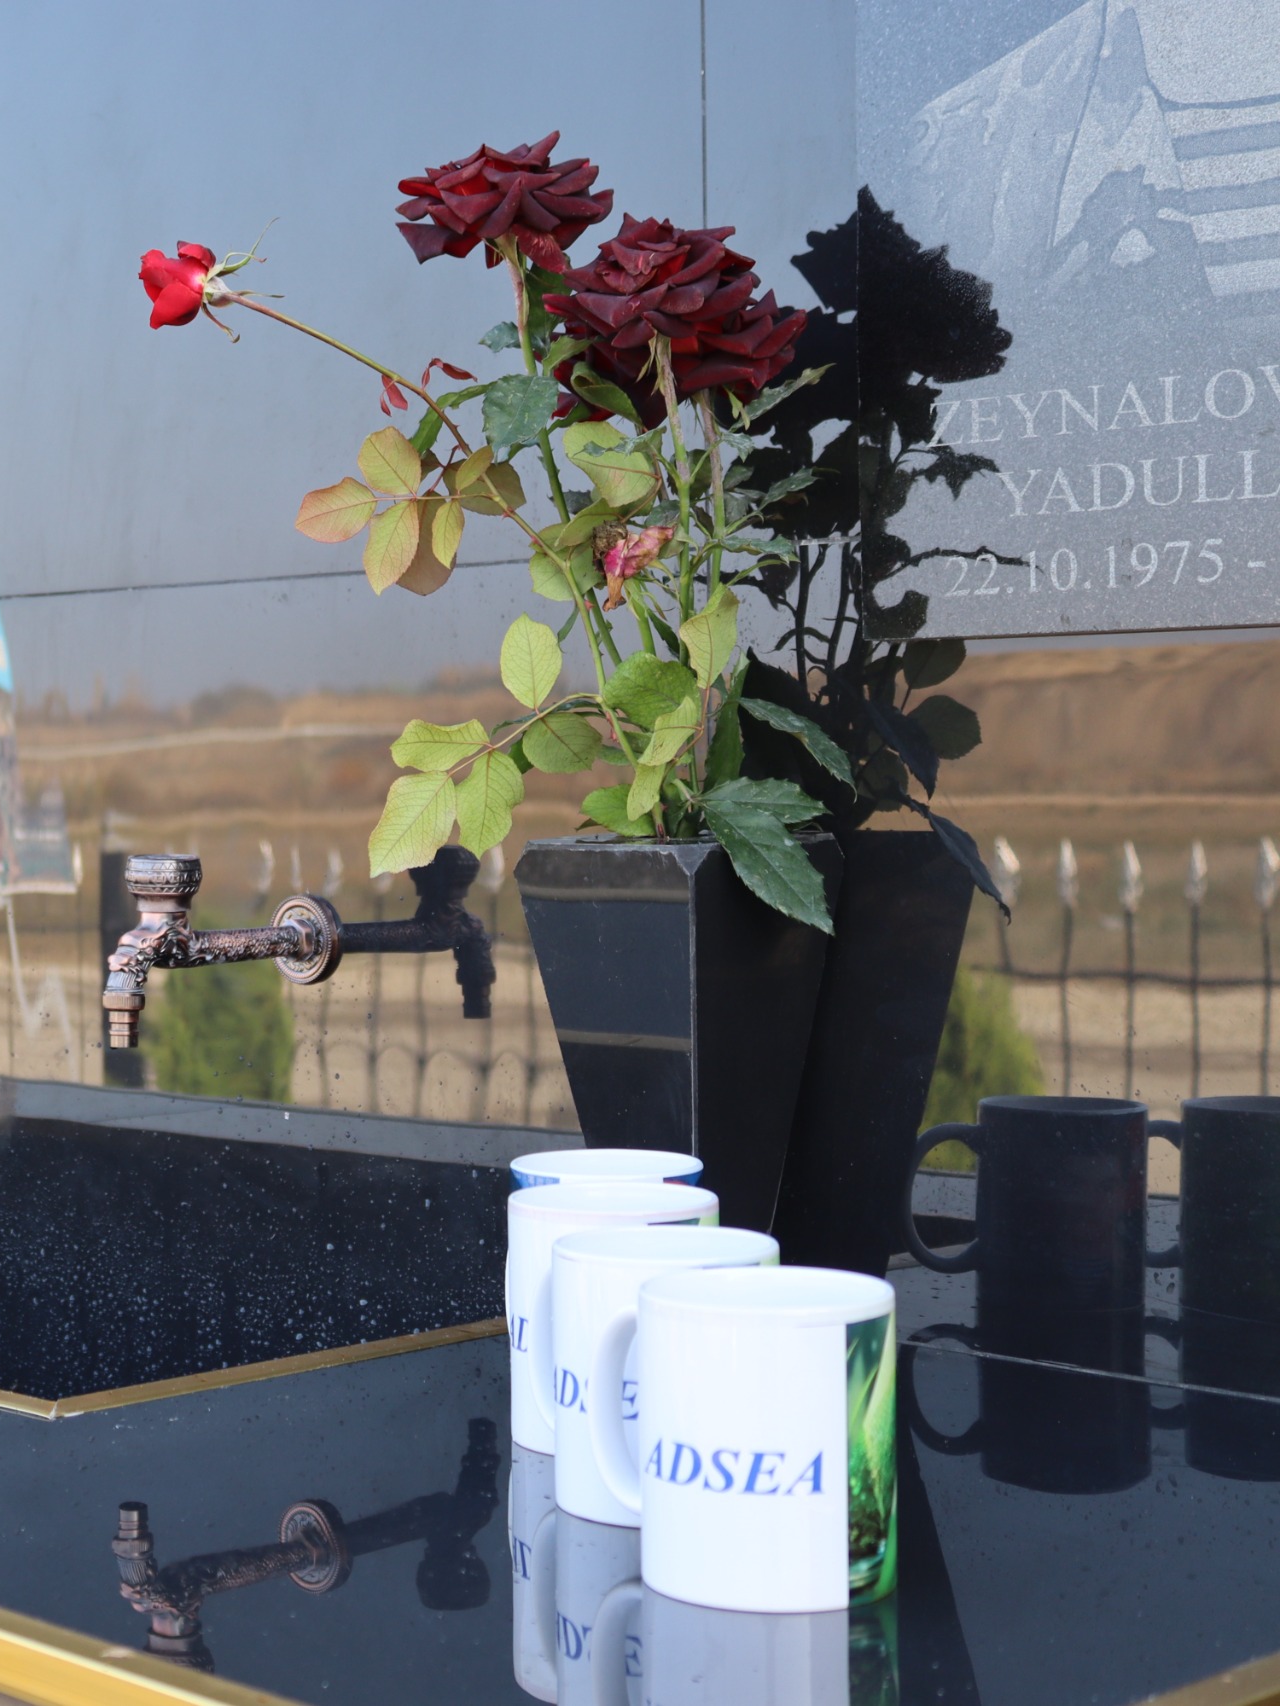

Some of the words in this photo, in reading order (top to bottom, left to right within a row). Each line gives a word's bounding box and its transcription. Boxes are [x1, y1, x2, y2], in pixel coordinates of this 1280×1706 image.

[998, 450, 1280, 517] YADULL
[944, 538, 1224, 598] 22.10.1975
[644, 1437, 826, 1495] ADSEA
